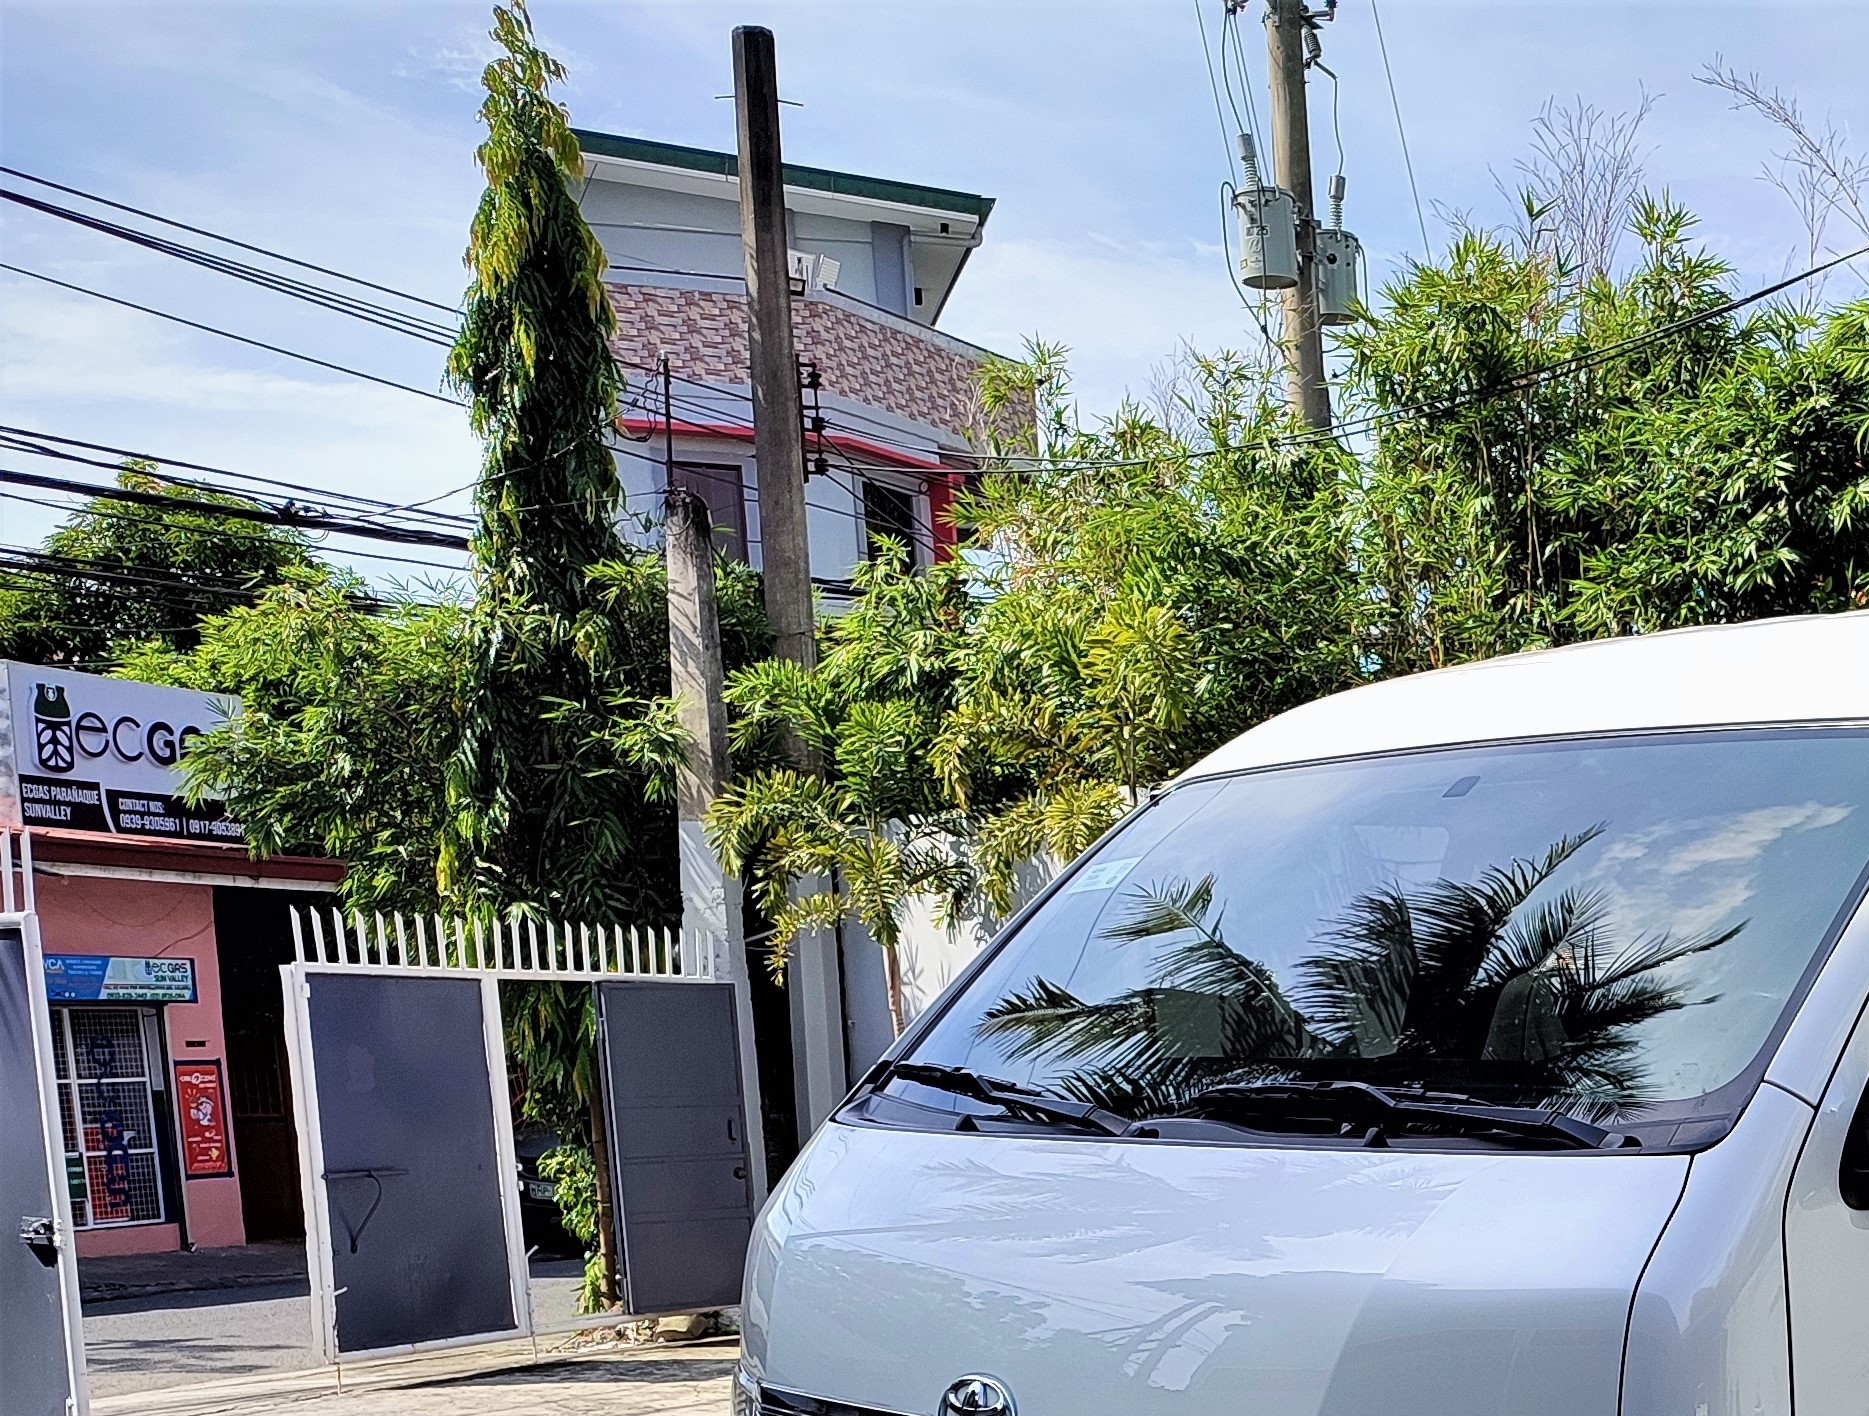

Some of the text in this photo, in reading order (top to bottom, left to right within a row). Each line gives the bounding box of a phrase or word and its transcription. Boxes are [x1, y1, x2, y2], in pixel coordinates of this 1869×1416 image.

[22, 783, 100, 804] ECGAS PARAÑAQUE
[24, 802, 71, 820] SUNVALLEY
[119, 798, 148, 812] CONTACT
[168, 975, 189, 983] VALLEY
